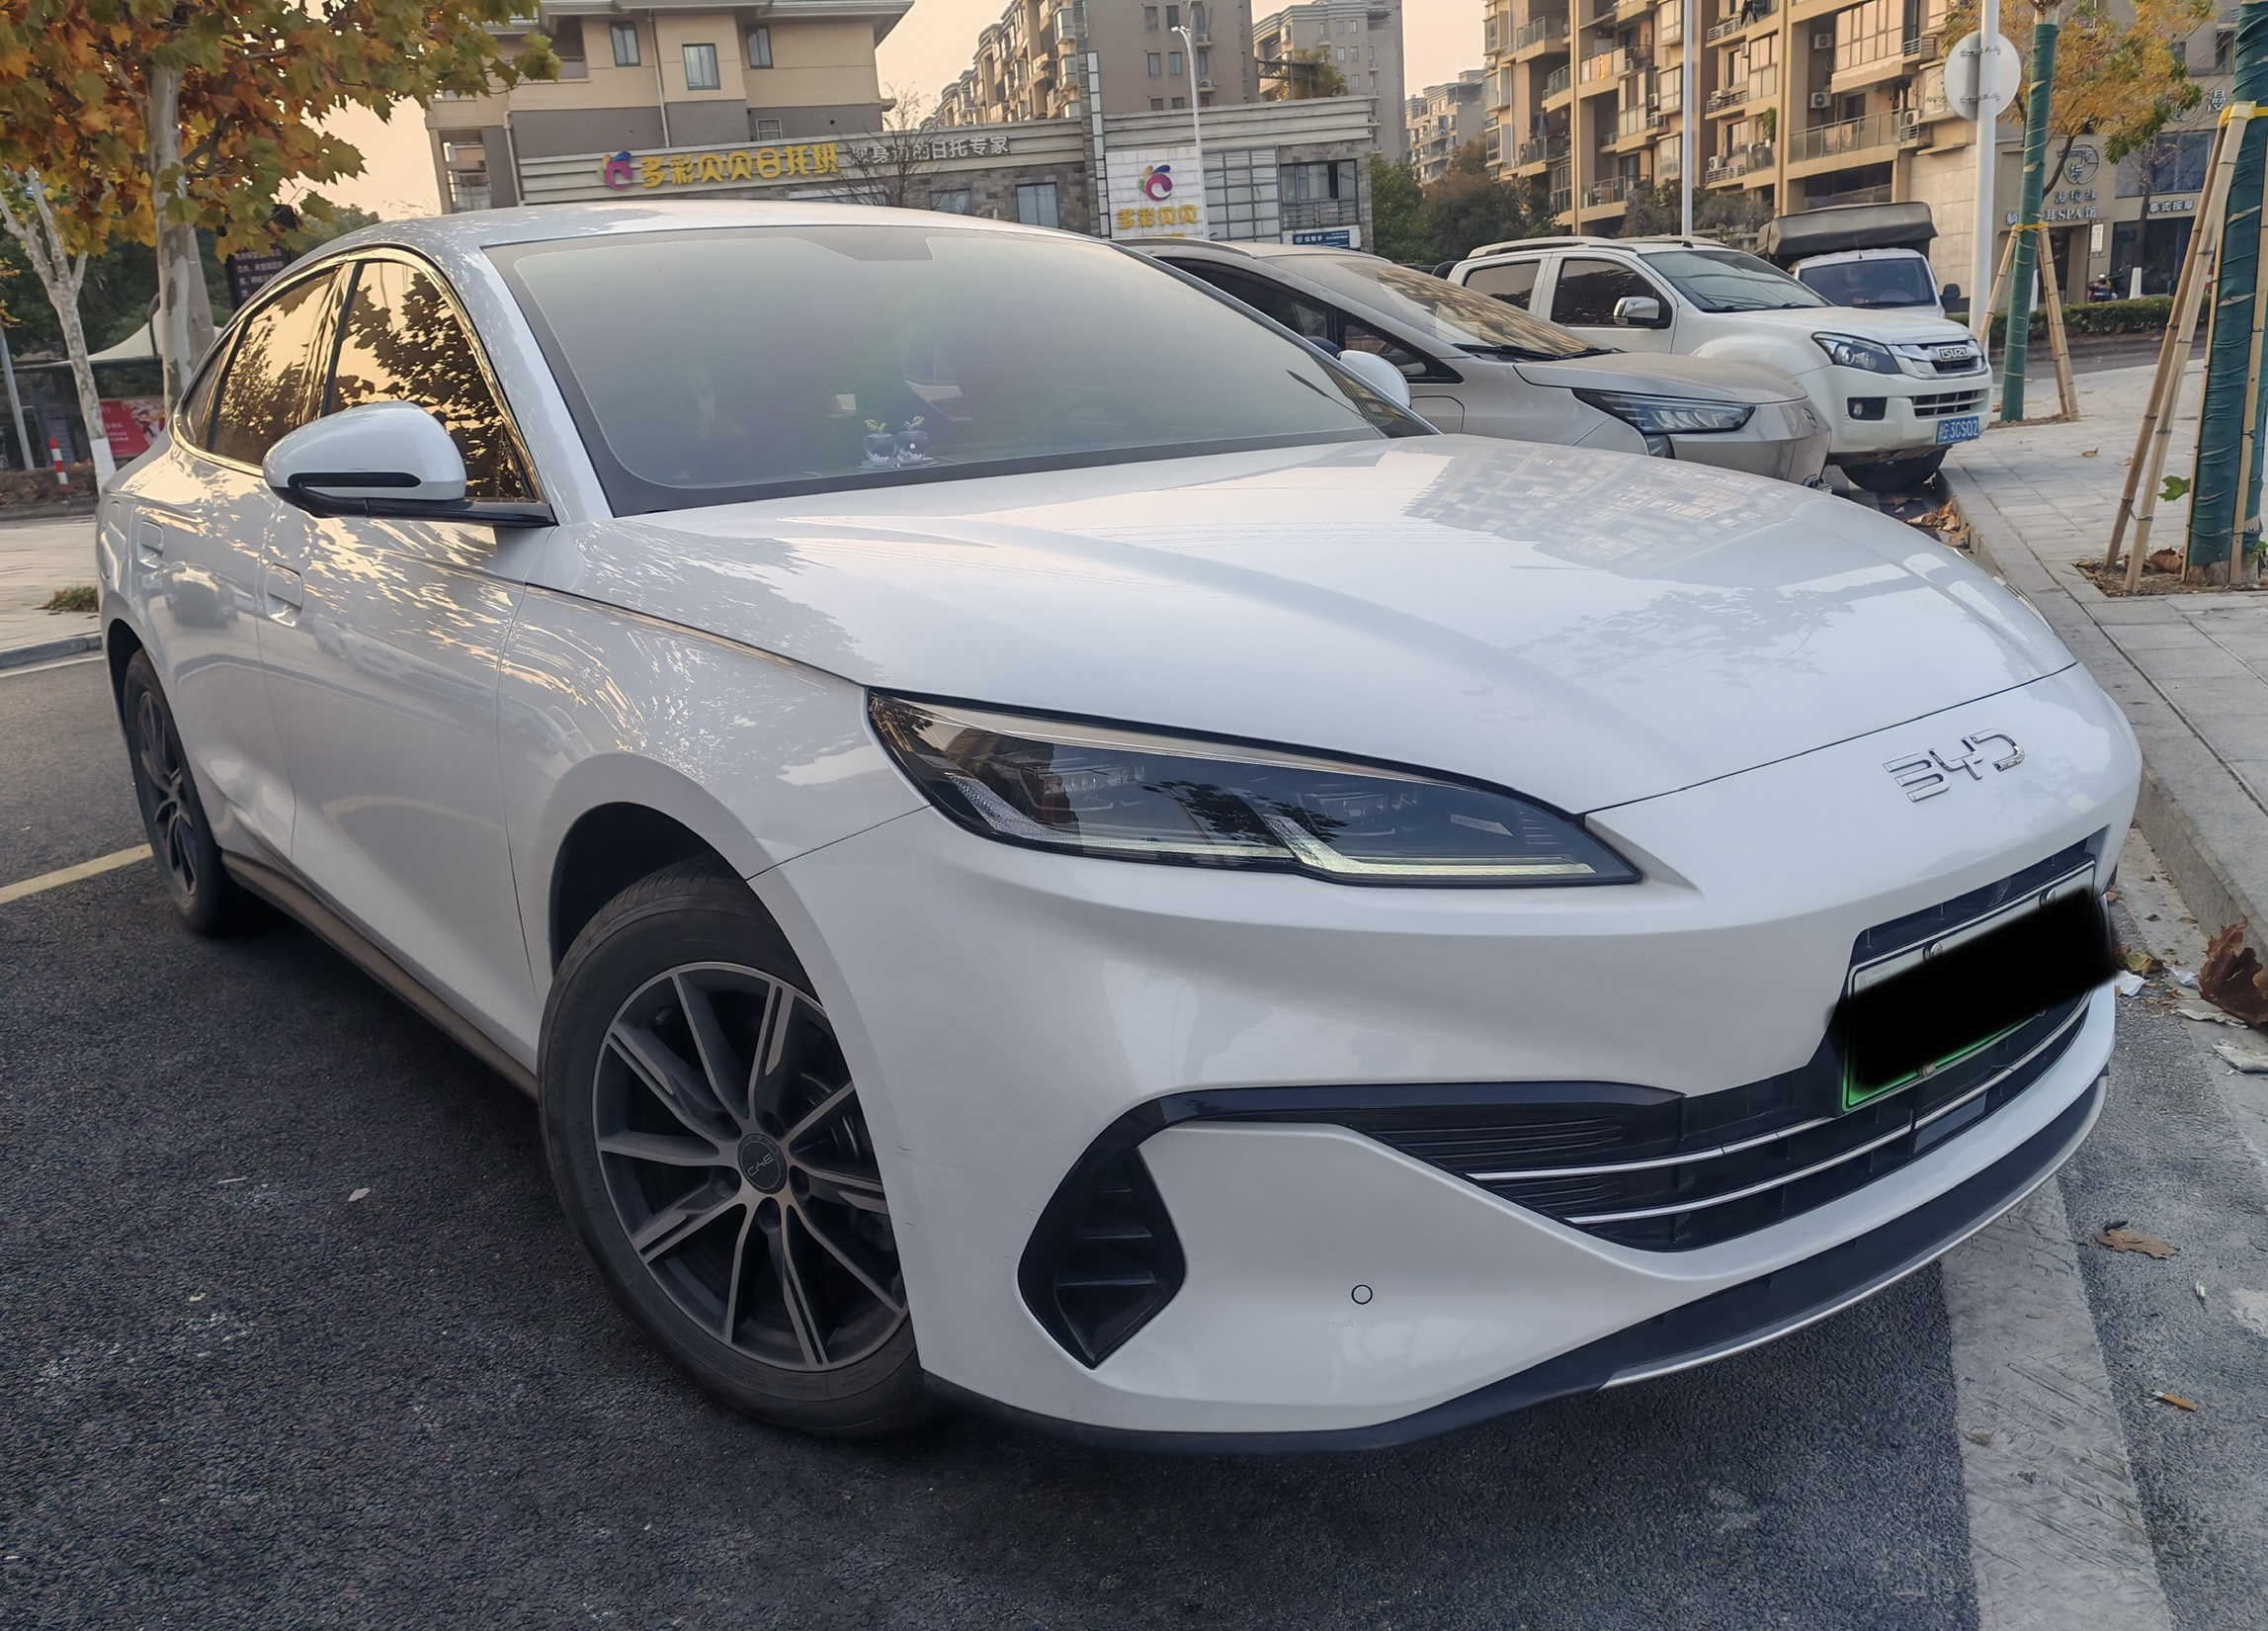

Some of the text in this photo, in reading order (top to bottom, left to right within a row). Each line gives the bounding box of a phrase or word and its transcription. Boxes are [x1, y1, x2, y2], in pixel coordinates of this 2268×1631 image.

[641, 142, 838, 188] 多彩贝贝日托班
[1117, 204, 1197, 229] 多彩贝贝
[1940, 348, 1969, 359] ISUZU
[1883, 729, 2025, 802] BYD
